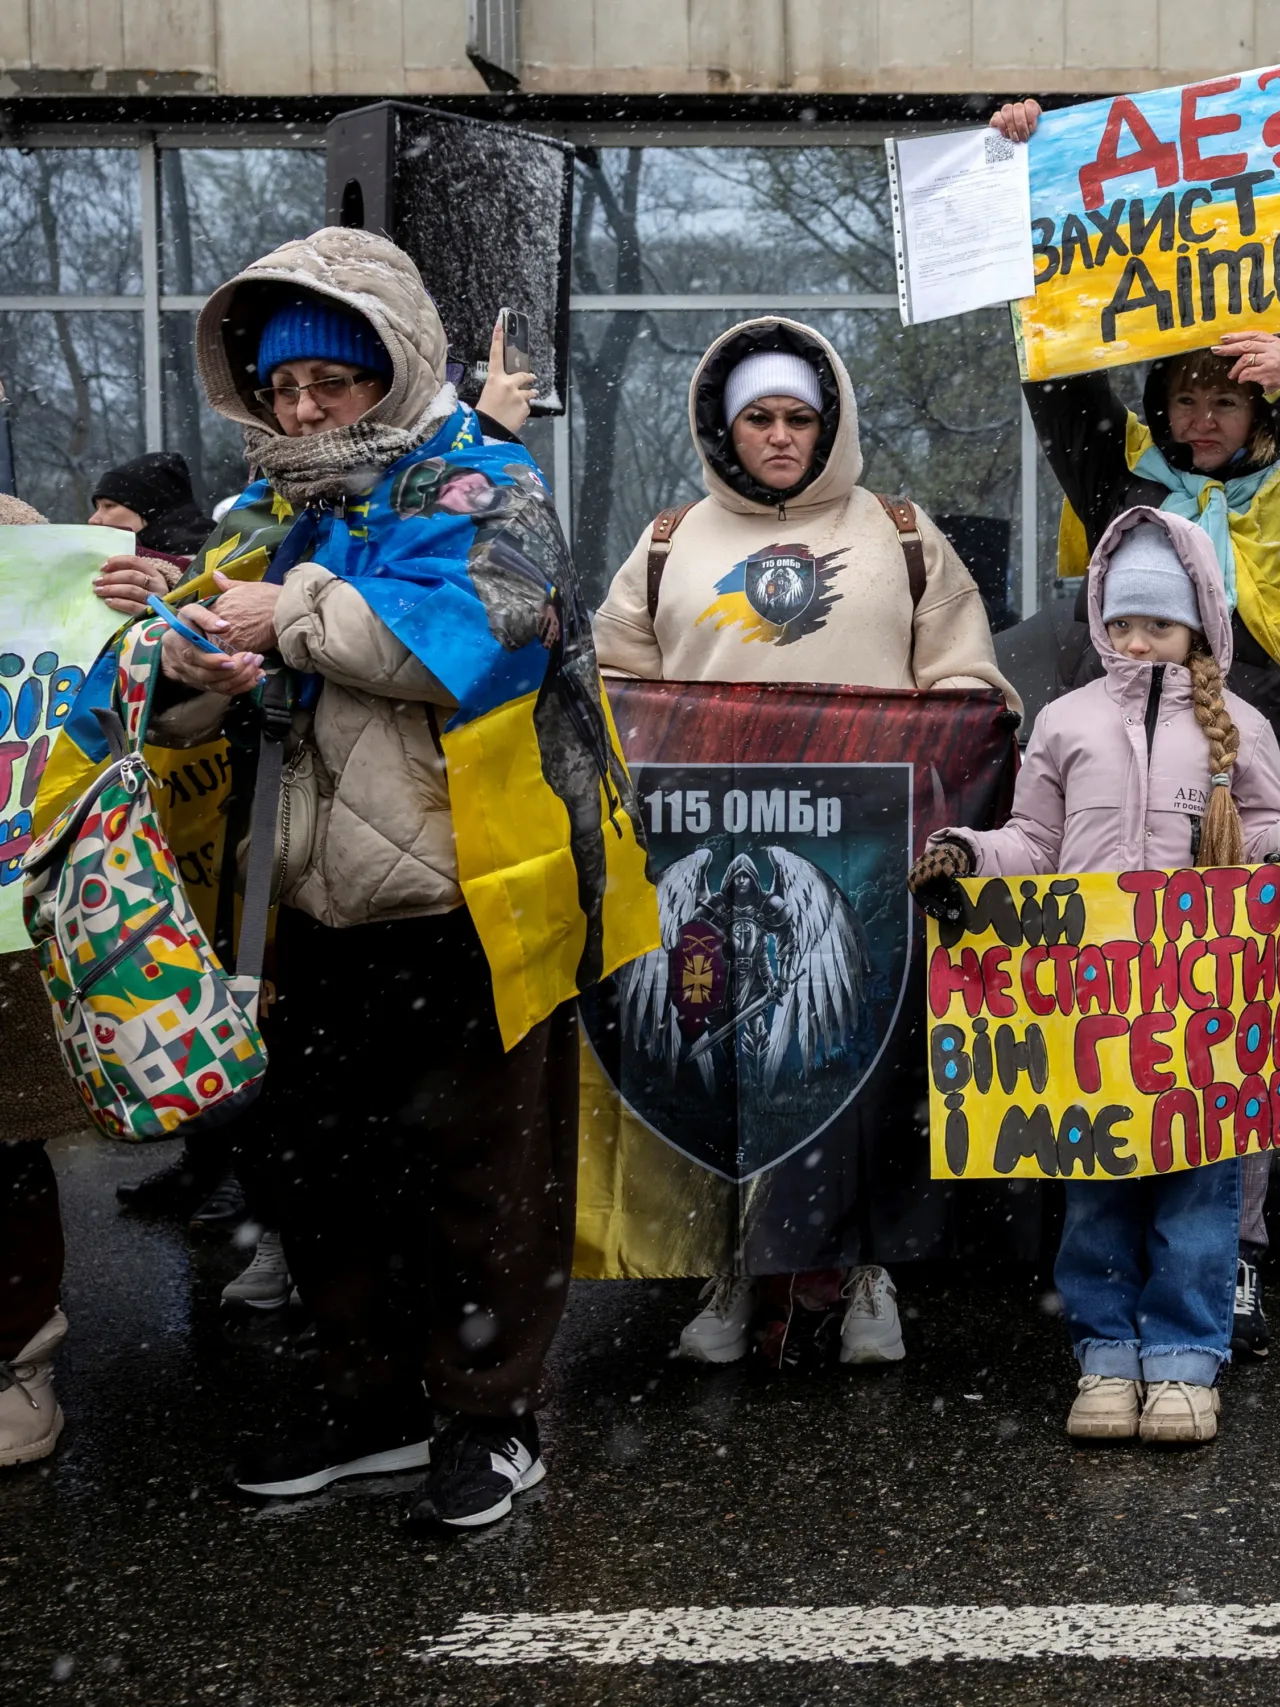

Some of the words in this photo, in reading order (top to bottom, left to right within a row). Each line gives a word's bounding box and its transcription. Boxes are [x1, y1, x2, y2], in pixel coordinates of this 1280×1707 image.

[1031, 170, 1275, 286] ЗАХИСТ
[762, 560, 775, 568] 115
[644, 790, 711, 833] 115
[723, 790, 841, 837] ОМБр
[993, 1104, 1138, 1177] МАЄ
